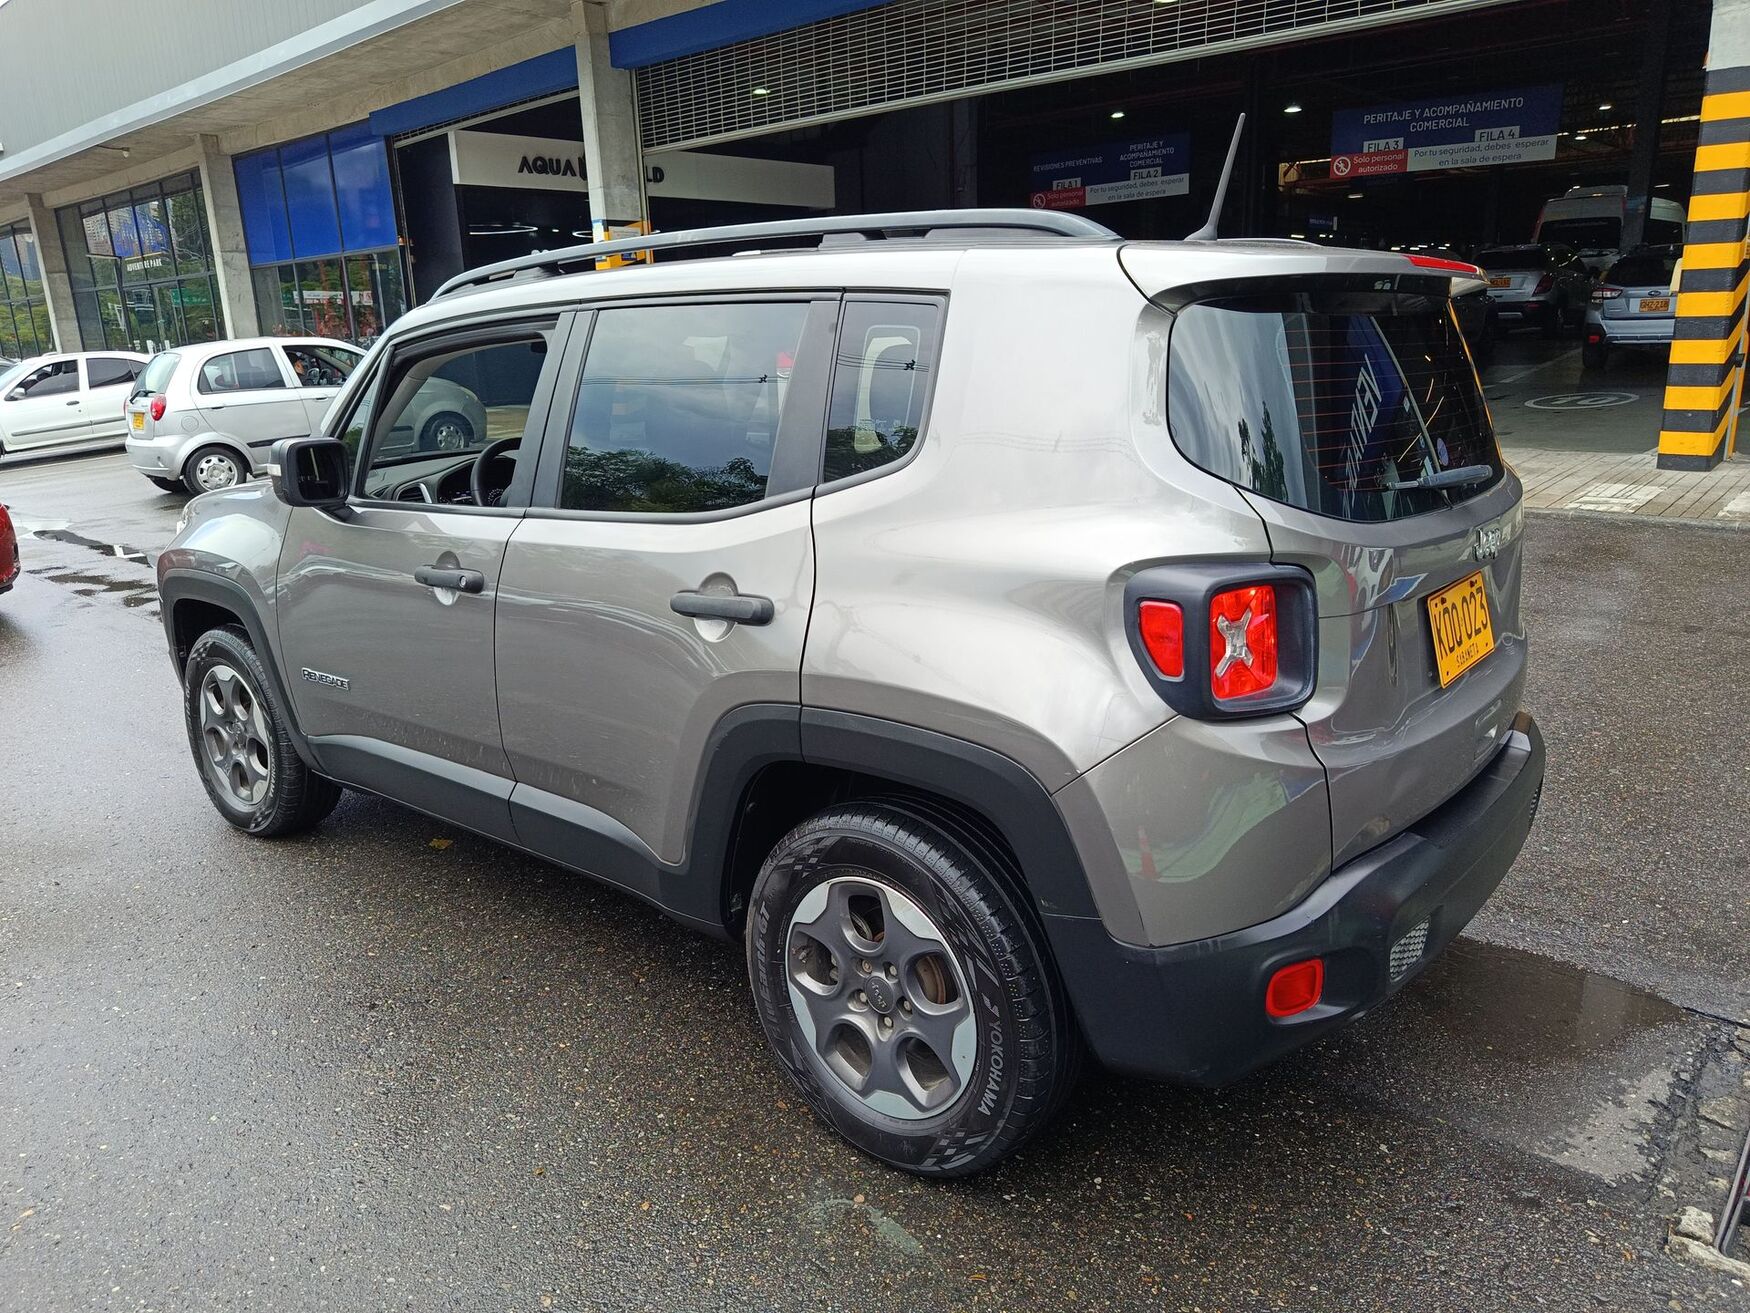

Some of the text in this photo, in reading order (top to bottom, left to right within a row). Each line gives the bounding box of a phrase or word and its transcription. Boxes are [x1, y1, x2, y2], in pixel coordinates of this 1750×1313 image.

[1364, 97, 1524, 124] PERITAJE Y ACOMPAÑAMIENTO
[1410, 117, 1469, 132] COMERCIAL
[1479, 129, 1515, 141] FILA 4
[1129, 142, 1159, 151] PERITAJE
[1367, 140, 1399, 152] FILA 3
[1438, 144, 1482, 156] seguridad,
[1484, 141, 1511, 151] debes
[1515, 139, 1549, 149] esperar
[1129, 158, 1164, 168] COMERCIAL
[1353, 152, 1404, 164] Solo personal
[1491, 153, 1521, 163] espera
[1359, 163, 1398, 173] autorizado
[1133, 169, 1158, 181] FILA 2
[302, 668, 350, 690] RENEGADE
[978, 1020, 1004, 1116] YOKOHAMA
